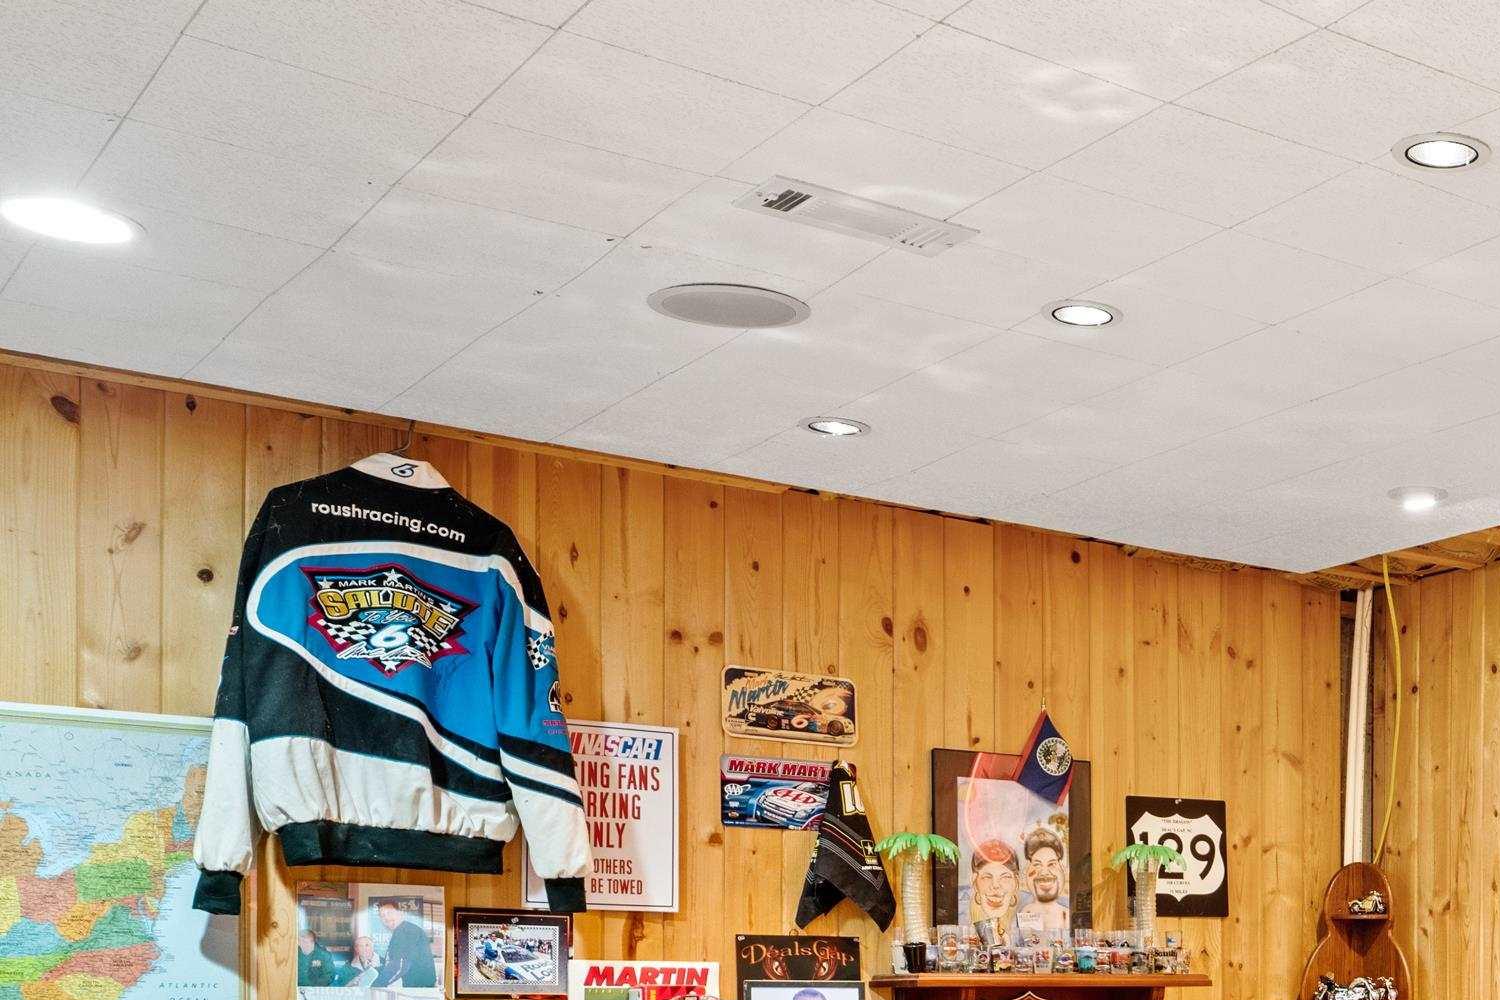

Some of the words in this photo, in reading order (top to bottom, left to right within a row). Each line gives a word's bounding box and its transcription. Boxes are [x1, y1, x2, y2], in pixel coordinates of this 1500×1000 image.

[391, 463, 419, 478] 6
[311, 500, 466, 544] roushracing.com
[338, 579, 377, 588] MARK
[317, 587, 460, 640] SALUTE
[369, 624, 410, 650] 6
[576, 733, 663, 760] NASCAR
[573, 760, 610, 788] ING
[618, 763, 660, 791] FANS
[728, 759, 780, 775] MARK
[782, 763, 828, 778] MART
[580, 790, 641, 820] RKING
[586, 822, 626, 849] NLY
[593, 858, 632, 875] OTHERS
[590, 878, 604, 894] BE
[607, 879, 643, 895] TOWED
[742, 941, 812, 964] Deals
[584, 966, 709, 986] MARTIN
